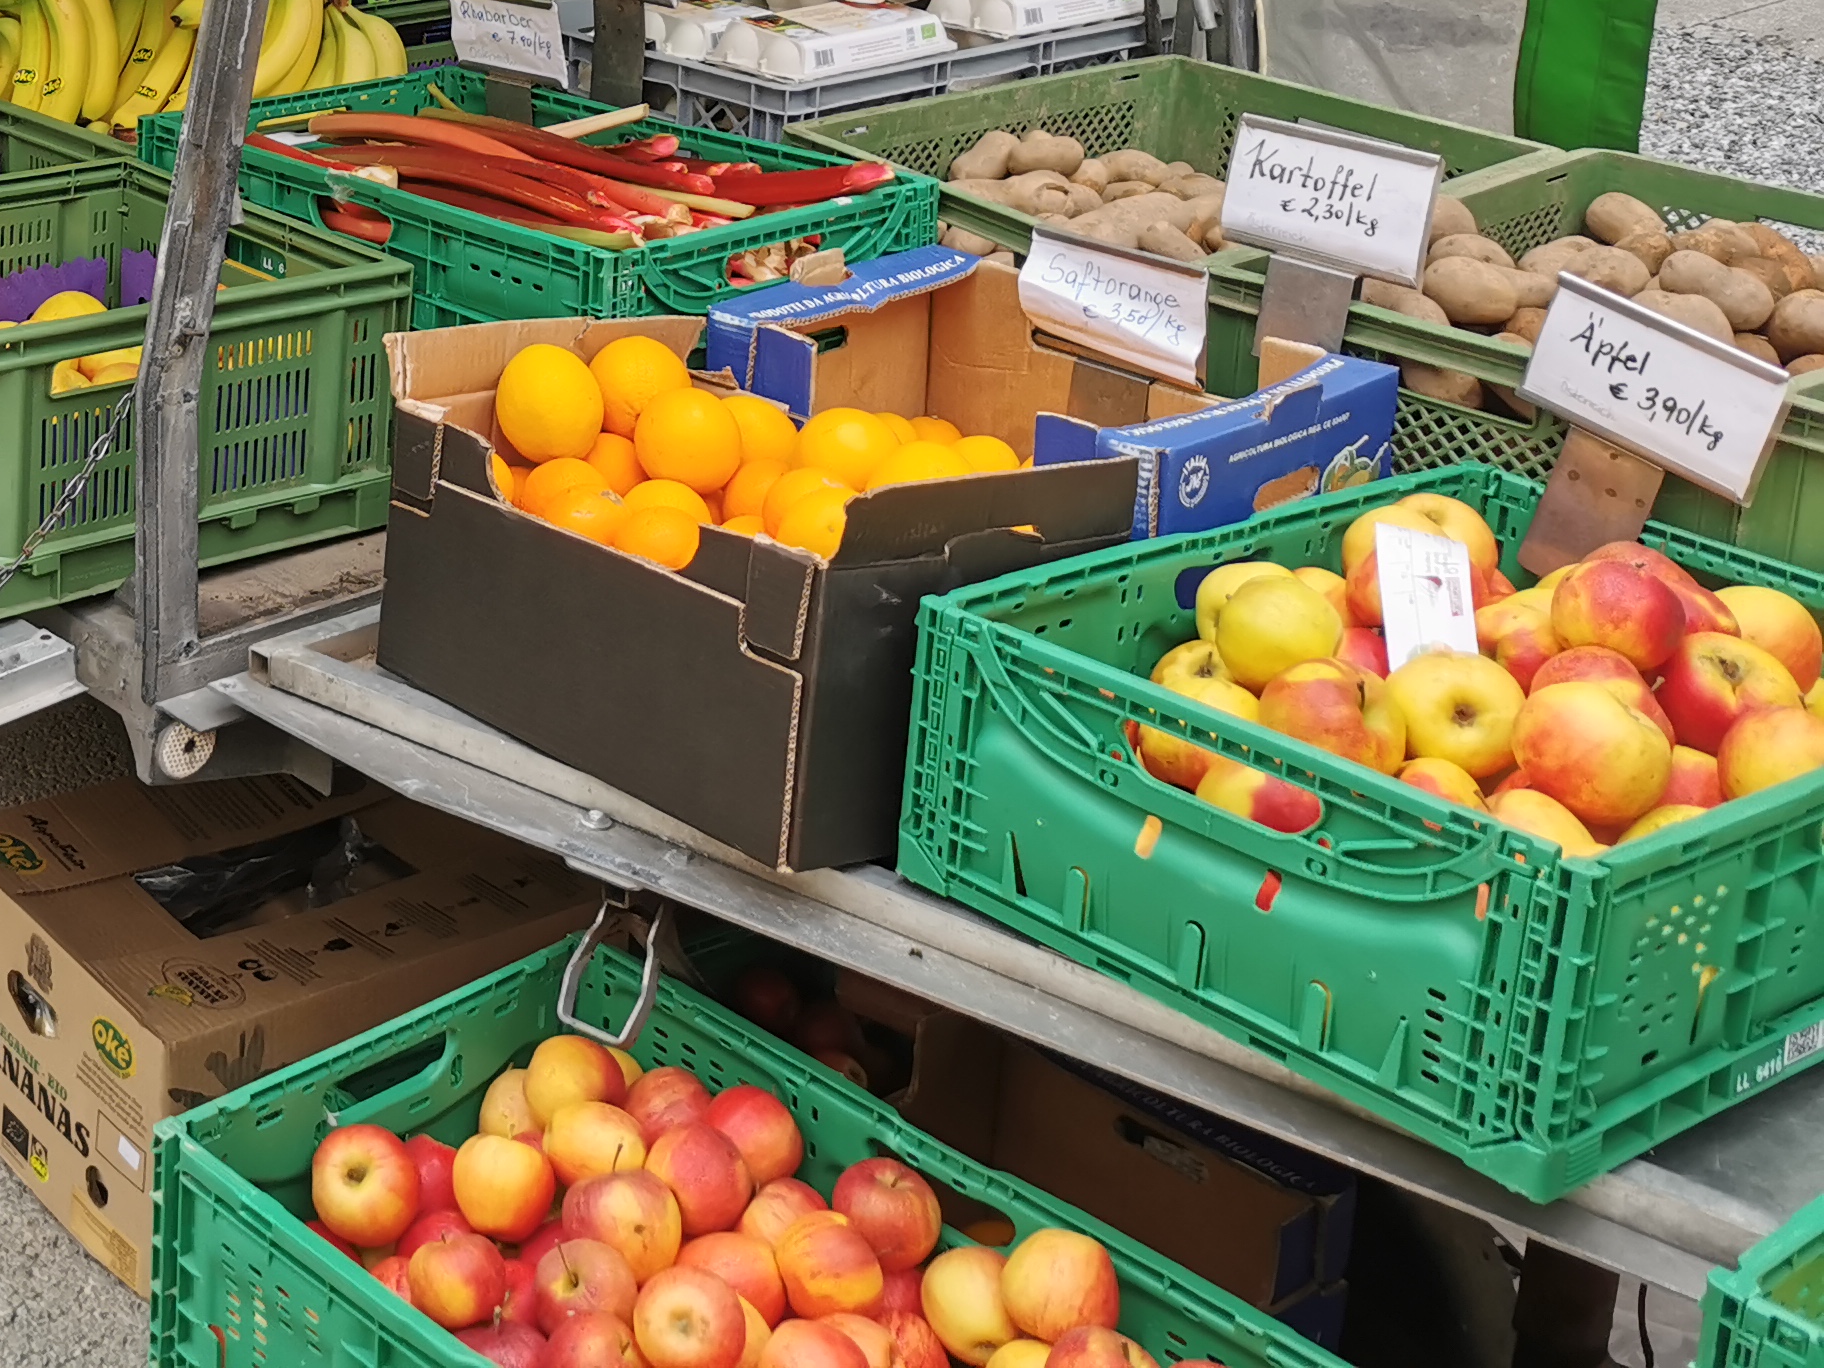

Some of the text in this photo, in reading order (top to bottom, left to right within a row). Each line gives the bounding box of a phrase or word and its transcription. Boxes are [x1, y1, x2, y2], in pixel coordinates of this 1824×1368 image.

[459, 0, 535, 29] Rhabarber
[1244, 138, 1378, 202] Kartoffel
[1280, 197, 1379, 237] € 2,30/kg
[262, 256, 274, 271] LL
[900, 254, 967, 289] BIOLOGICA
[1041, 252, 1181, 320] Saftorange
[1081, 304, 1099, 319] €
[1569, 311, 1651, 376] Äpfel
[1608, 383, 1724, 451] € 3,90/kg
[94, 1021, 133, 1063] oké
[46, 1076, 69, 1103] BIO
[1736, 1071, 1750, 1093] LL
